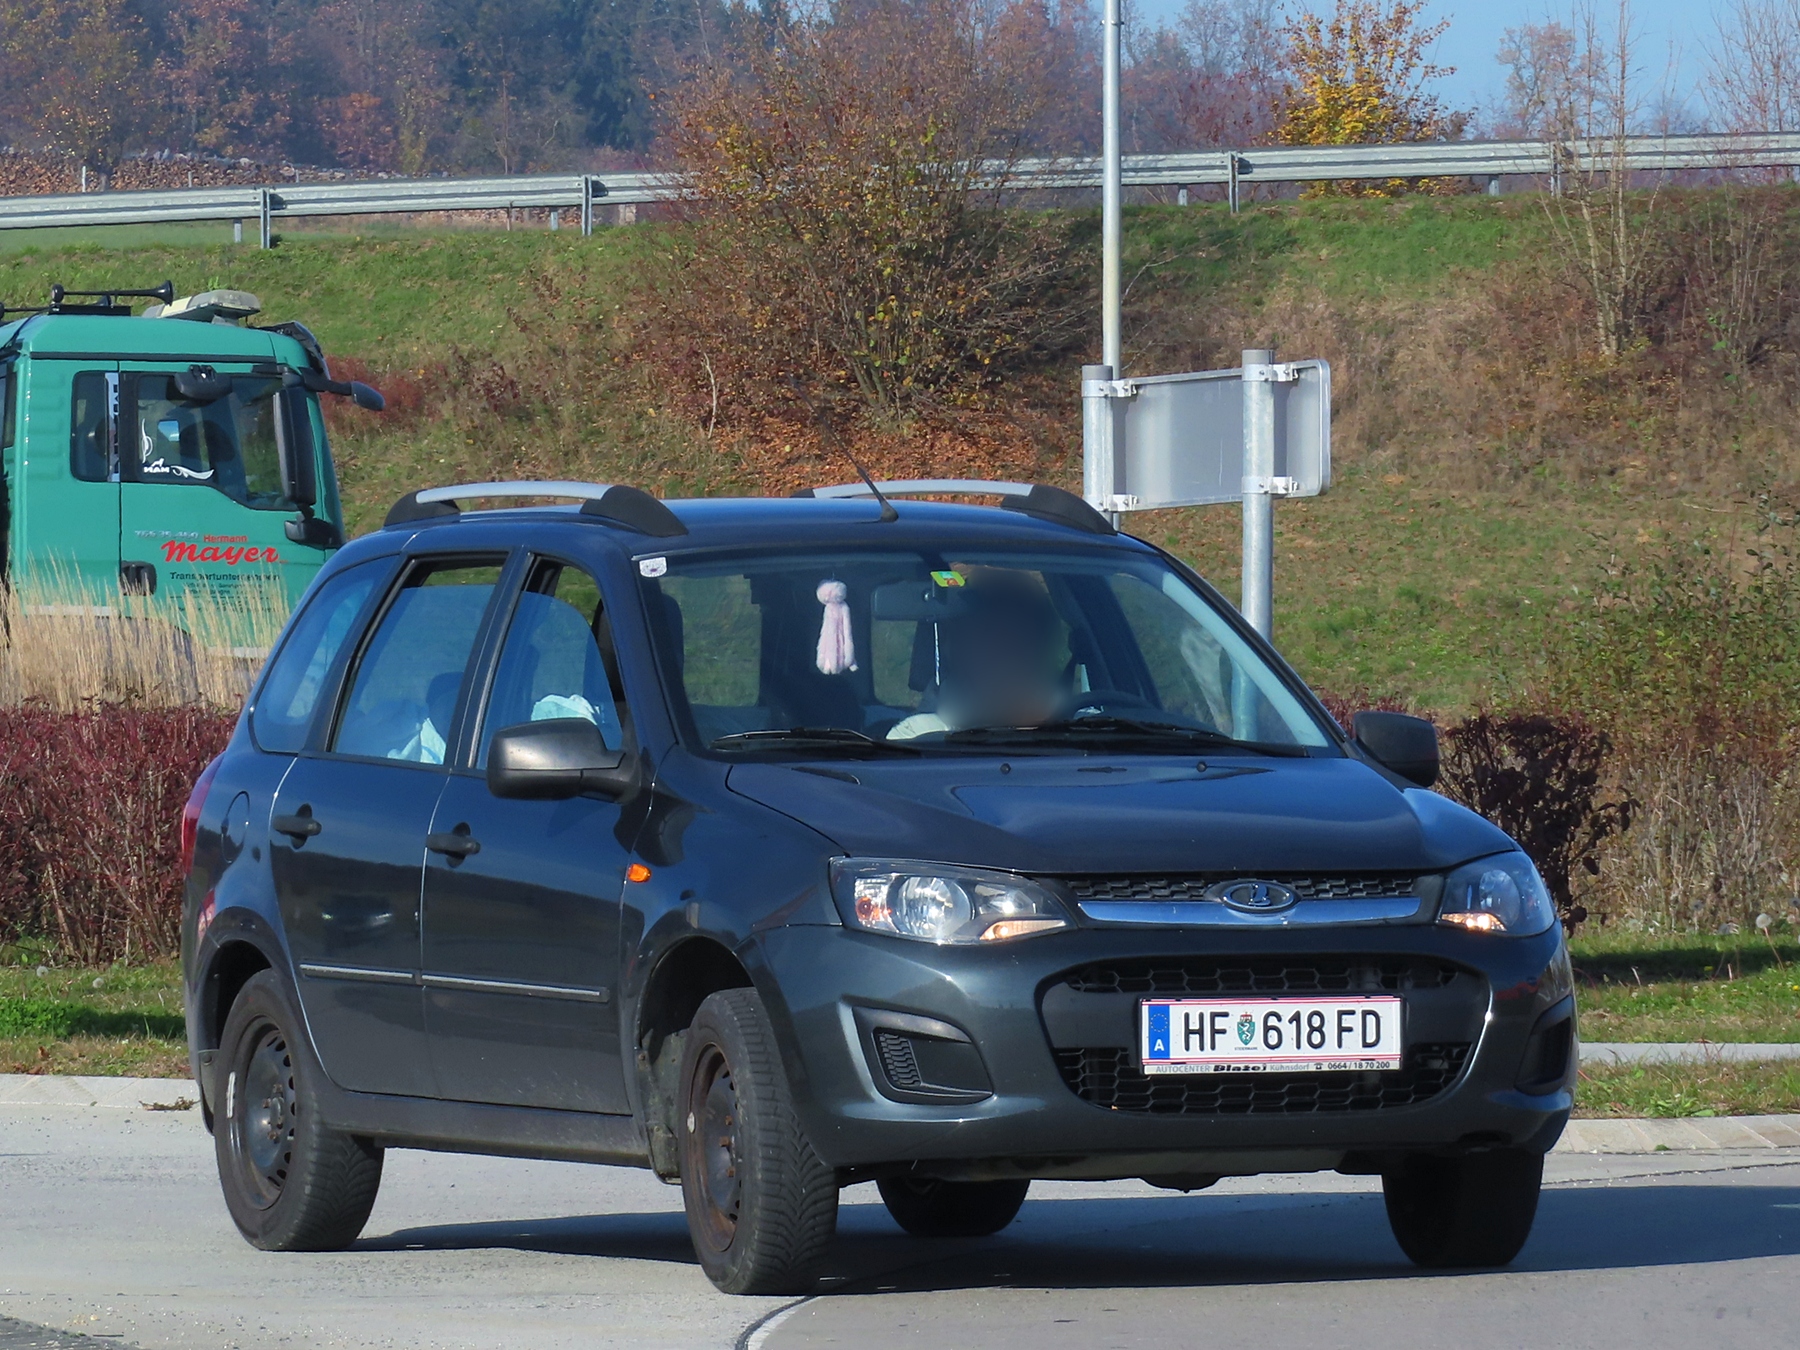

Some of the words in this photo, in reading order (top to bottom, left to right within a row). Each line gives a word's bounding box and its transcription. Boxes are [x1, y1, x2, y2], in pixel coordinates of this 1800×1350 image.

[204, 534, 248, 543] Hermann
[161, 540, 279, 565] Mayer
[1184, 1011, 1230, 1052] HF
[1262, 1010, 1326, 1050] 618
[1336, 1009, 1381, 1049] FD
[1153, 1039, 1165, 1051] A
[1156, 1065, 1210, 1073] AUTOCENTER
[1327, 1062, 1348, 1070] 0664
[1354, 1061, 1363, 1069] 18
[1364, 1061, 1375, 1069] 70
[1376, 1060, 1391, 1069] 200
